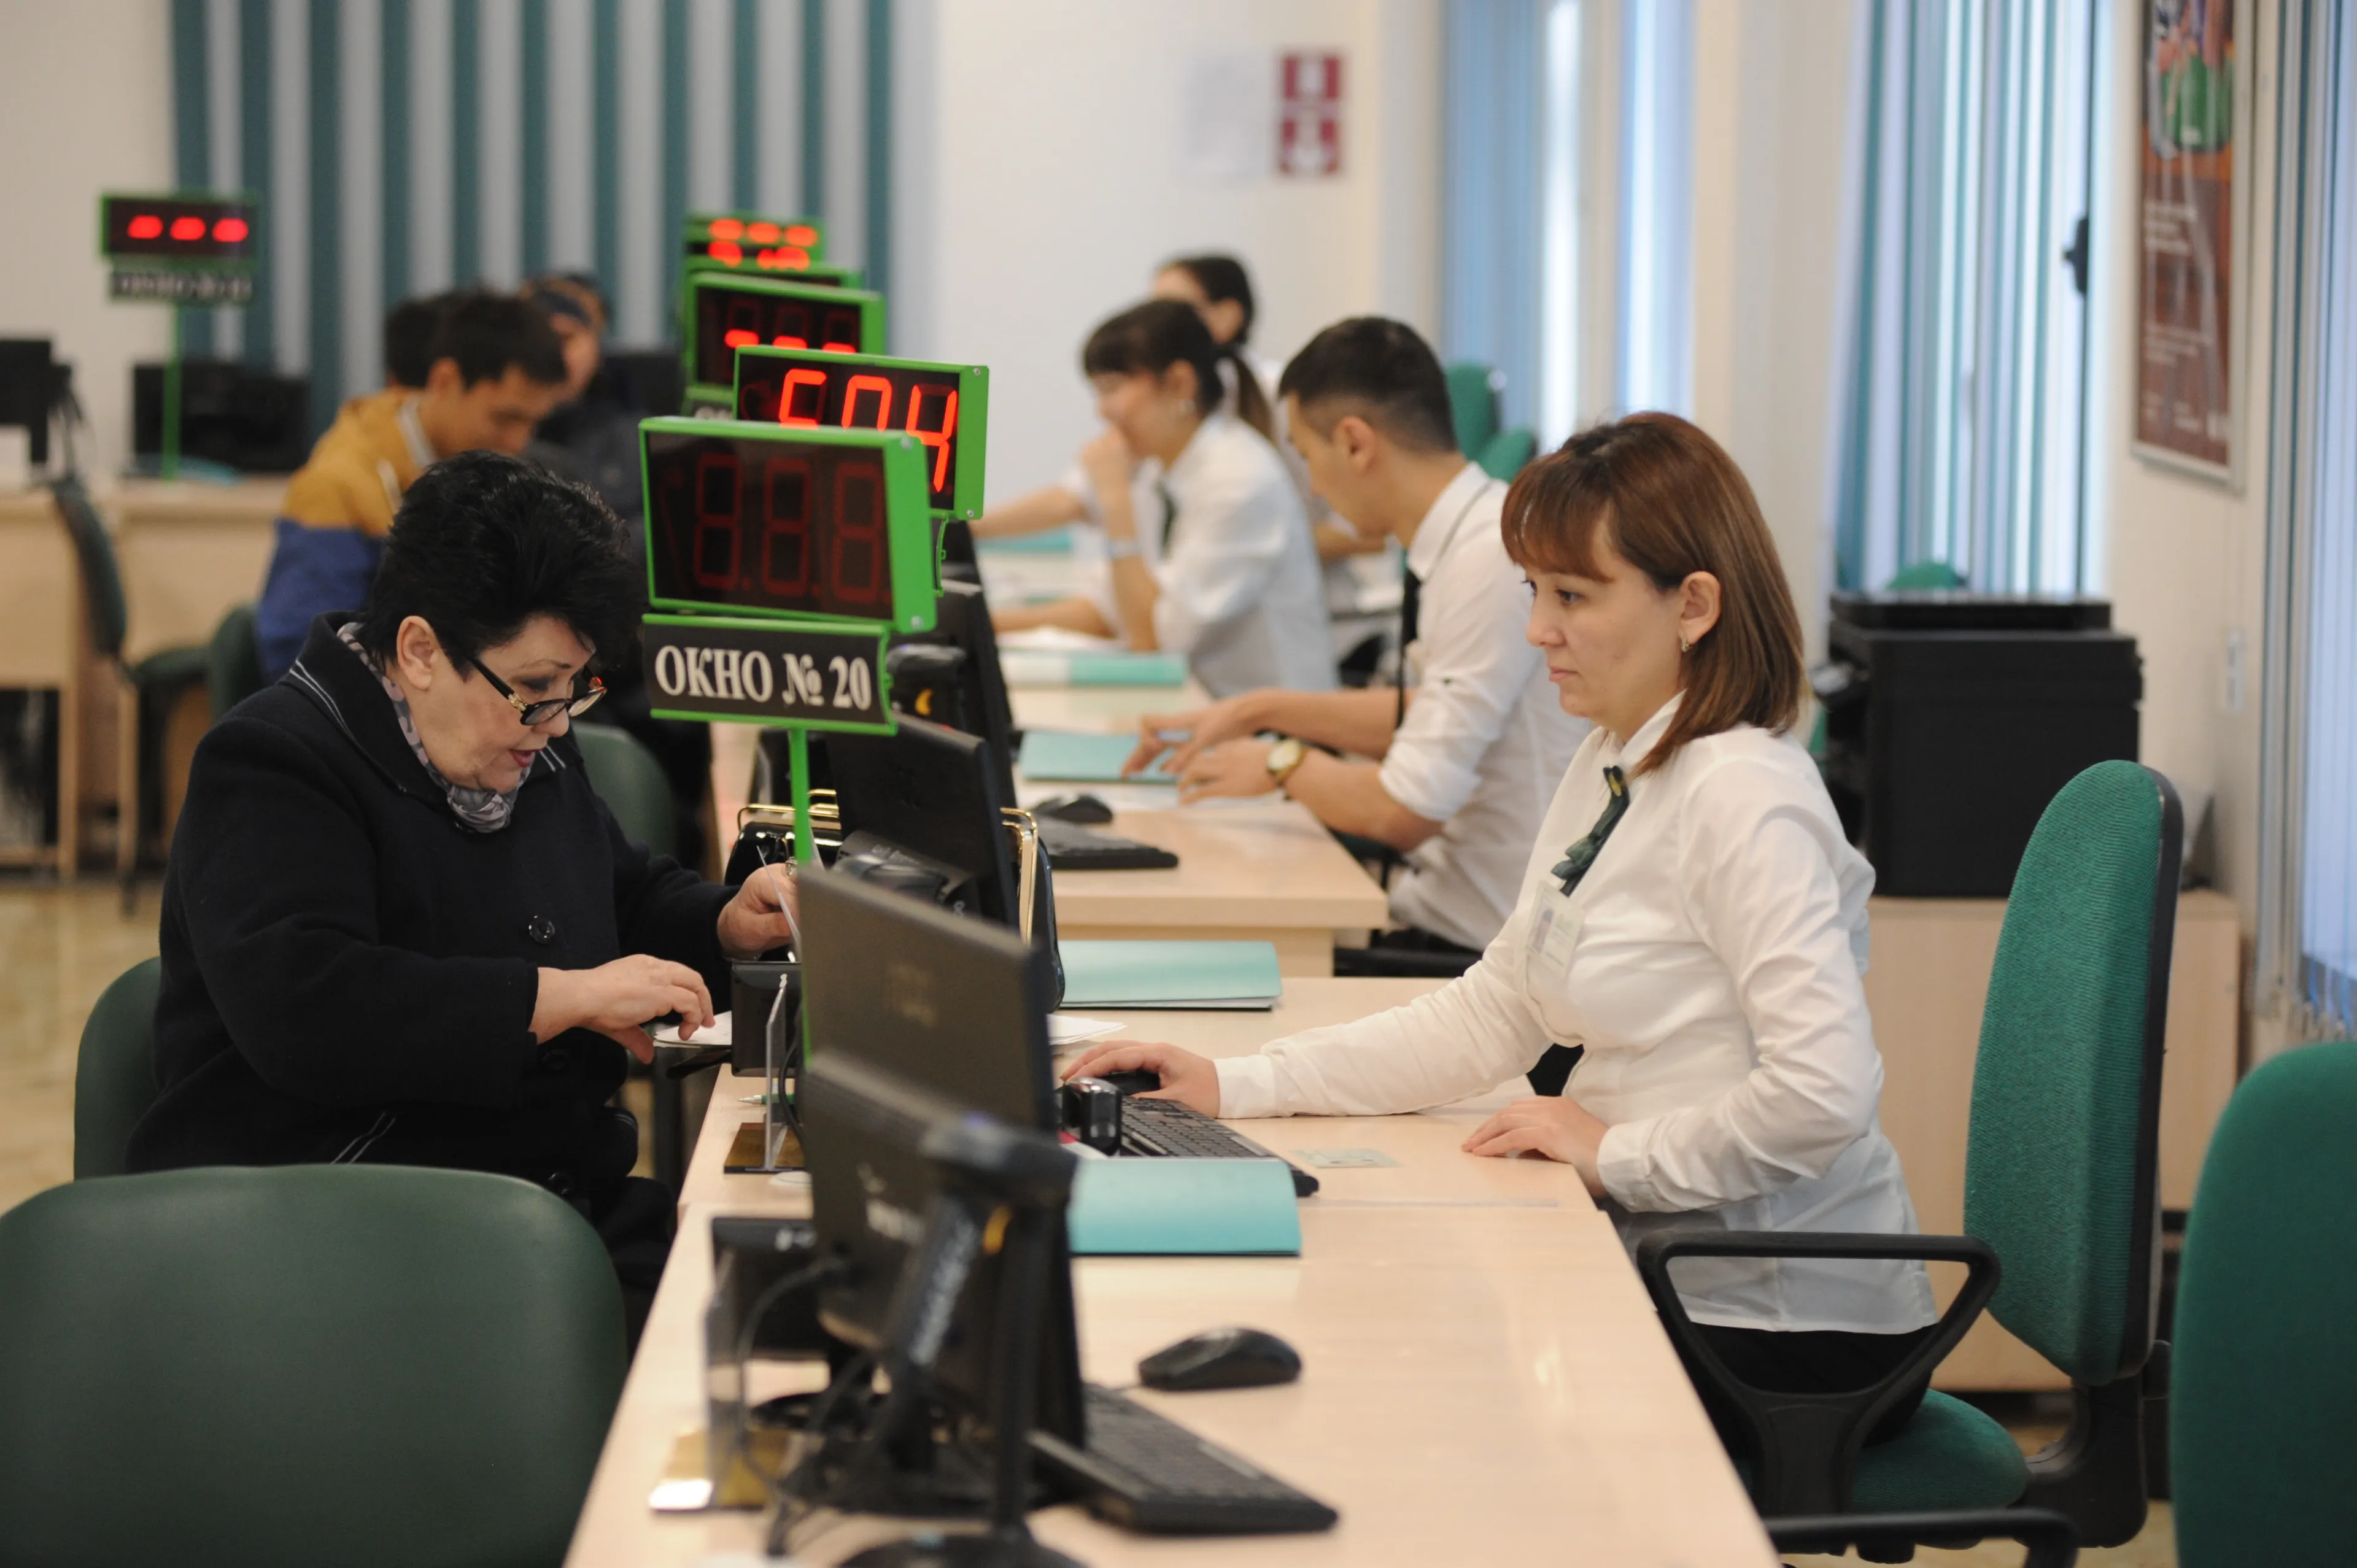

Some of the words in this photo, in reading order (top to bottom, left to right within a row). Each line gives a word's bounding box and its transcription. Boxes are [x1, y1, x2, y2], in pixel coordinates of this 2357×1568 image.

[654, 644, 773, 703] ОКНО
[781, 653, 824, 706] №
[829, 655, 872, 711] 20
